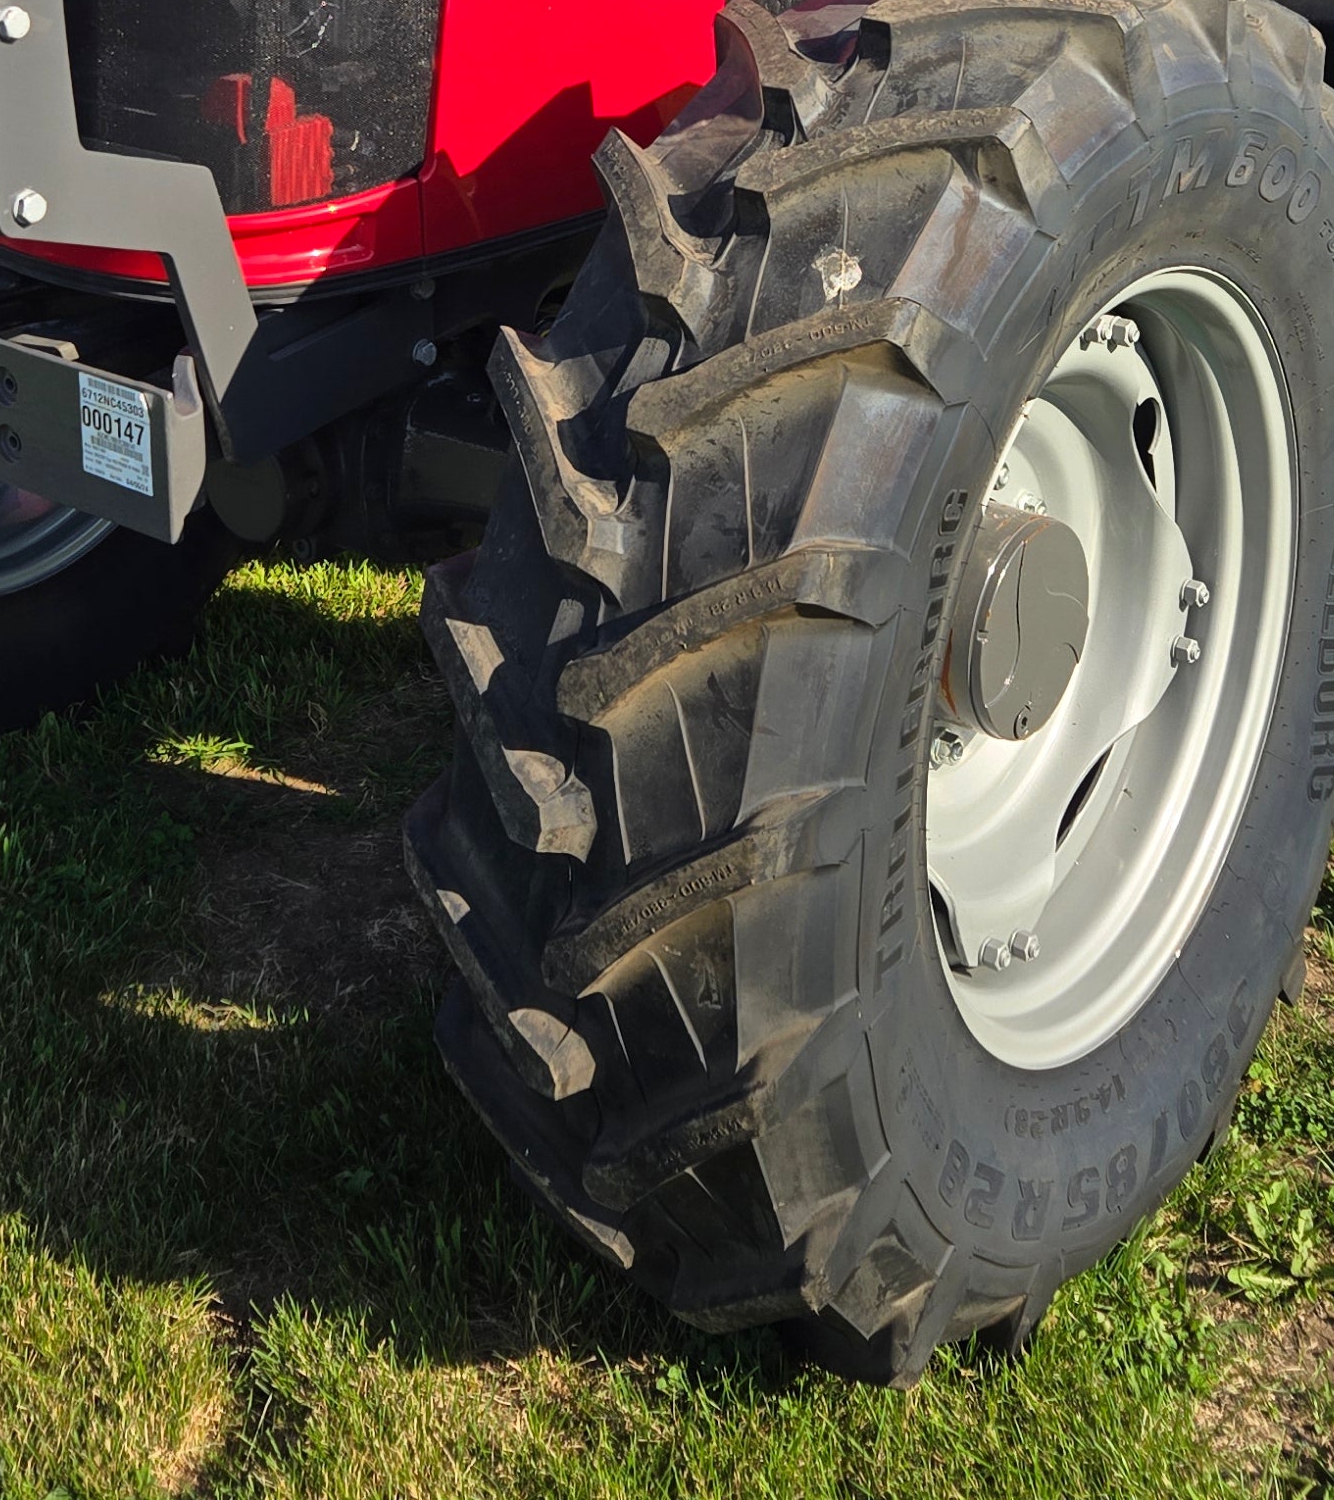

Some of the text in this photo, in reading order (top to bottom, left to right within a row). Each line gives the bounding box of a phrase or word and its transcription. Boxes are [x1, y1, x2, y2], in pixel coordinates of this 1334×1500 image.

[1224, 128, 1322, 226] 600
[82, 405, 145, 446] 000147
[872, 486, 968, 994] TRELLEBORG
